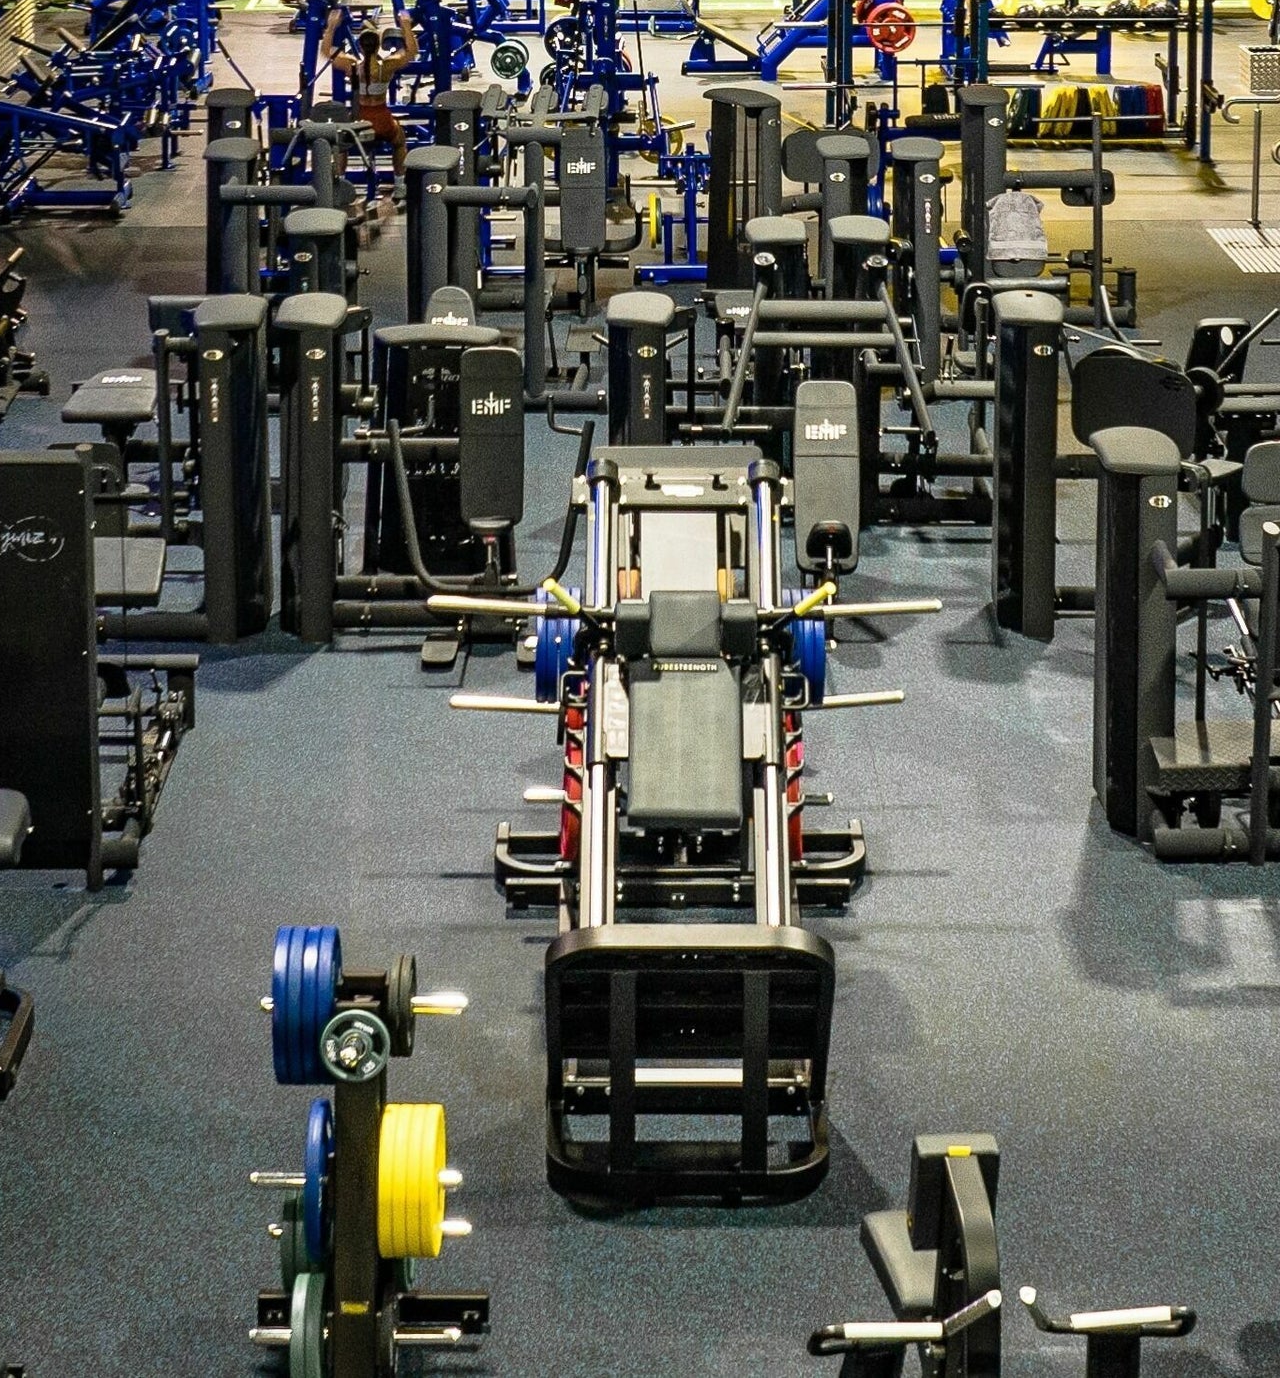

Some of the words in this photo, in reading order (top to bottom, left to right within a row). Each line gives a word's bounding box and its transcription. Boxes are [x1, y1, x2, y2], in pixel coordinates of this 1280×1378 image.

[567, 157, 597, 175] EMF
[471, 391, 512, 416] EMF
[804, 418, 847, 441] EMF
